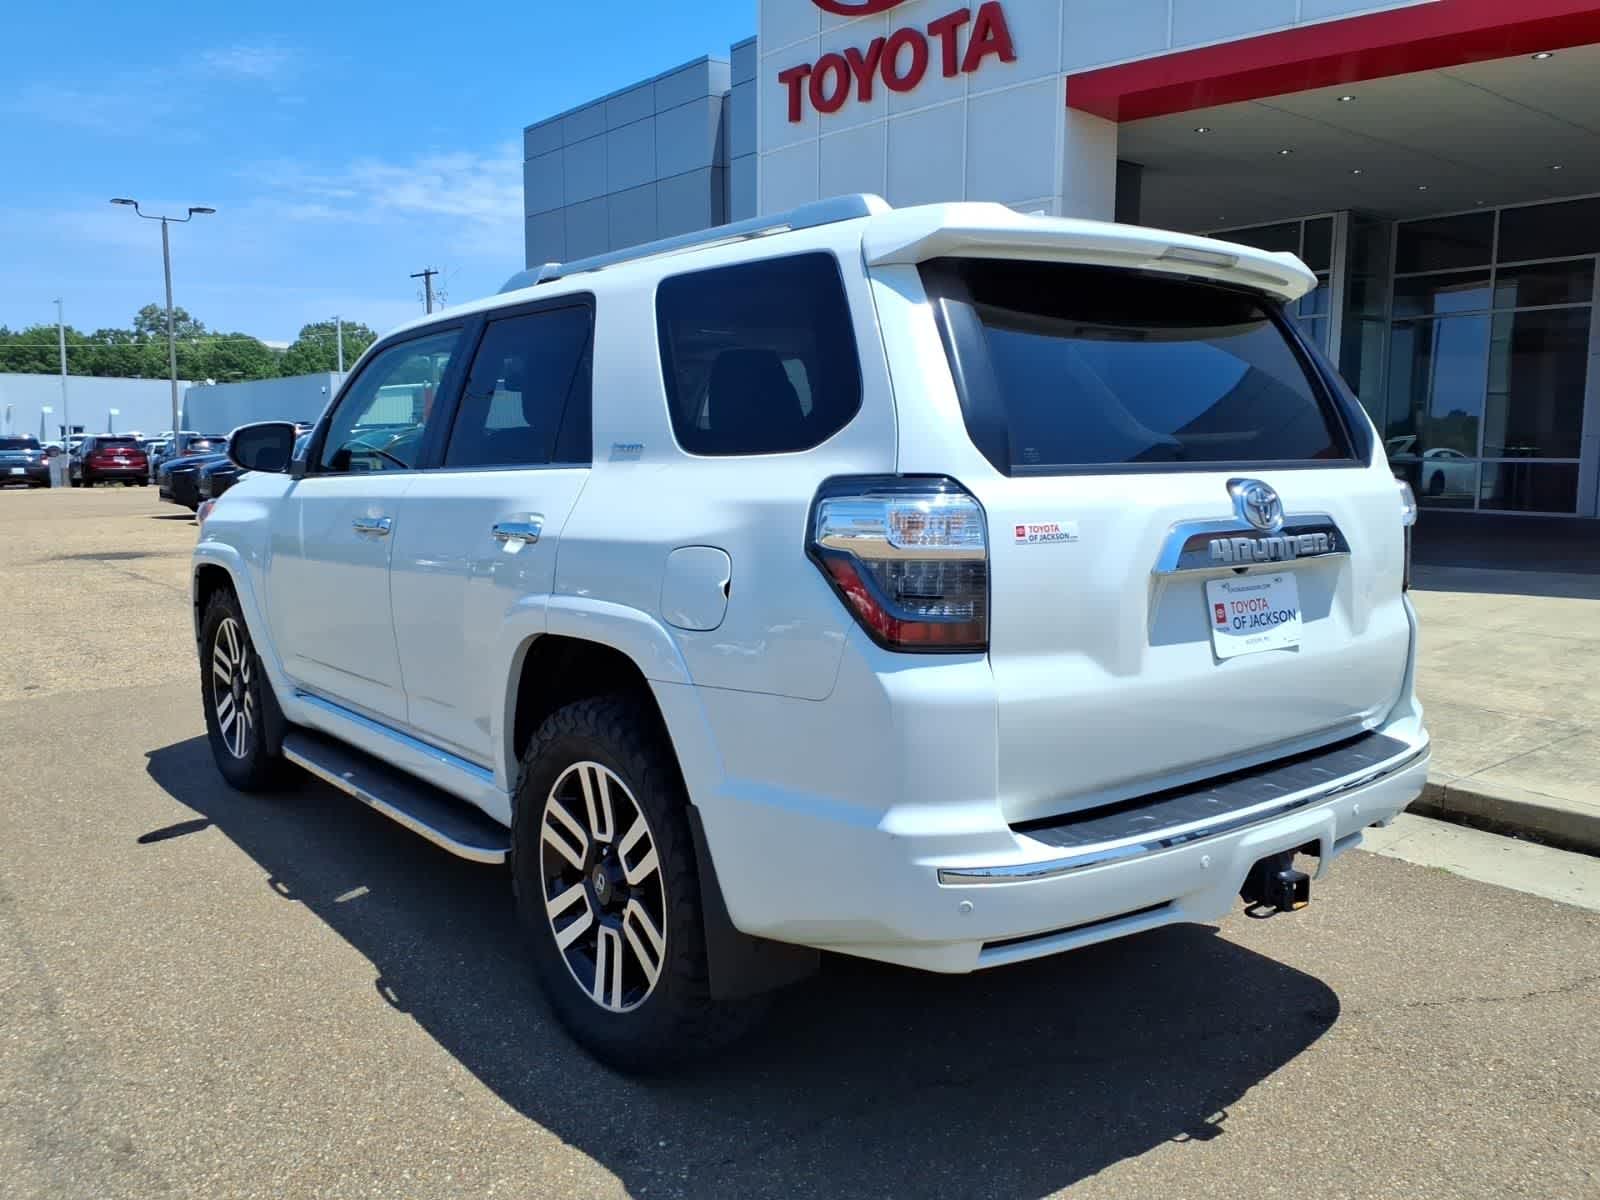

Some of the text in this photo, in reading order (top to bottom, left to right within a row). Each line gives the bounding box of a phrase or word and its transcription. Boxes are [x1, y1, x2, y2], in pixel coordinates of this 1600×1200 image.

[778, 0, 1017, 123] TOYOTA
[1028, 524, 1060, 533] TOYOTA
[1028, 532, 1070, 542] OF JACKSON
[1230, 598, 1269, 615] TOYOTA
[1233, 608, 1297, 630] OF JACKSON
